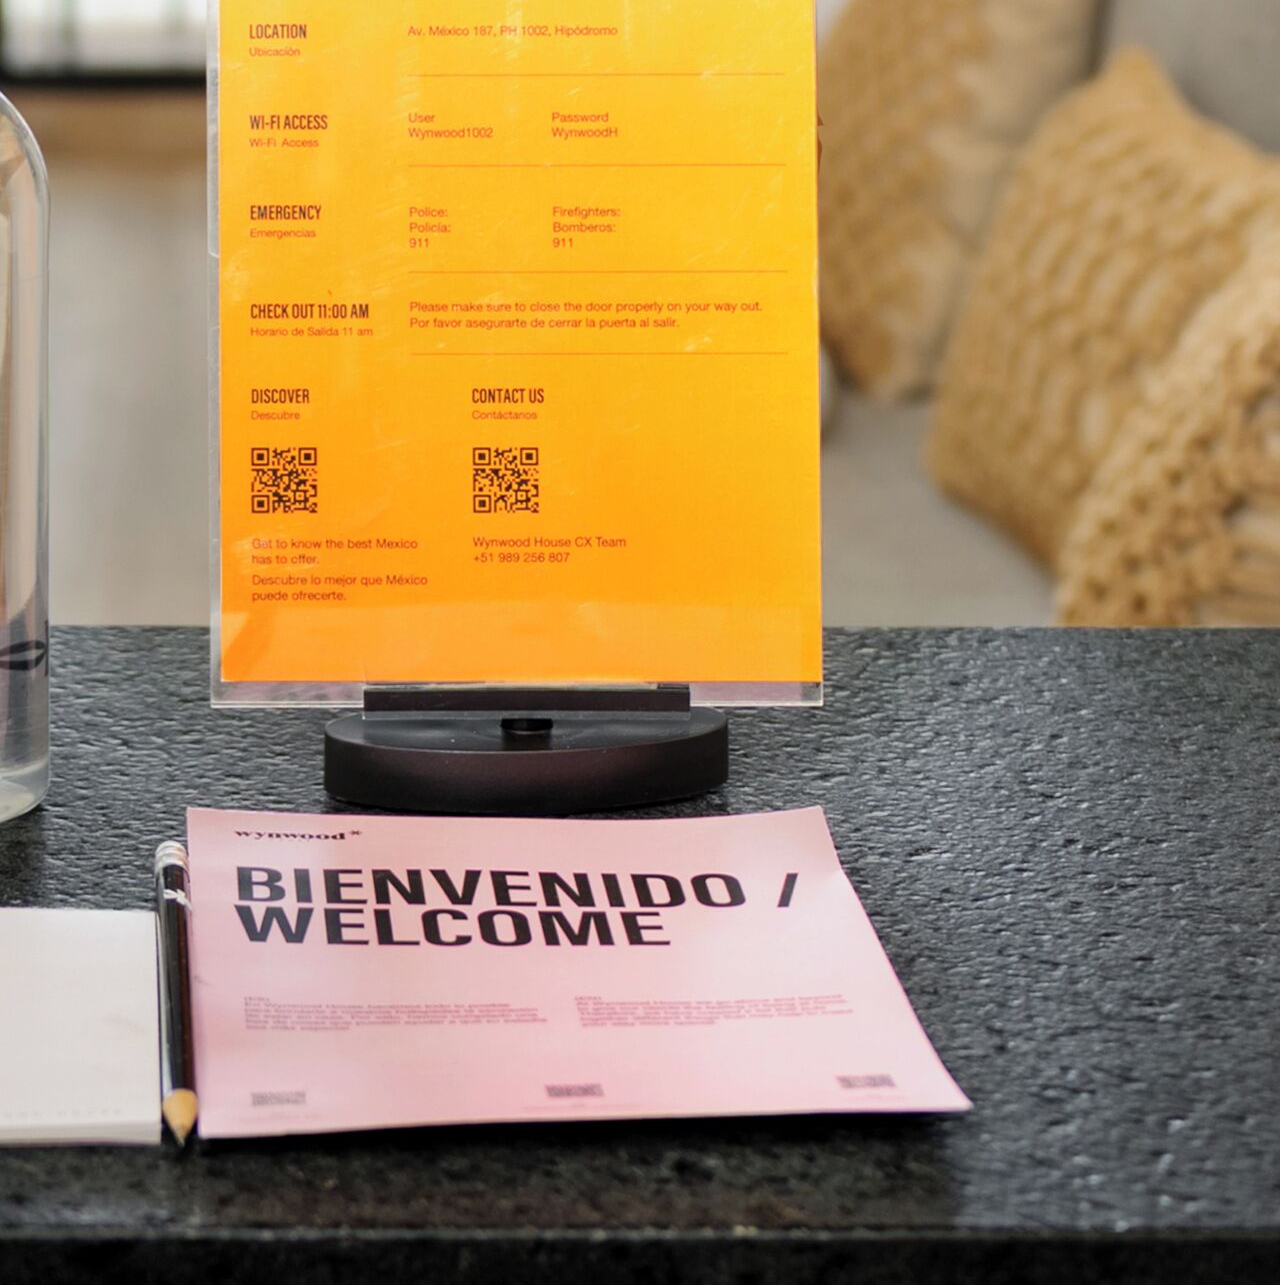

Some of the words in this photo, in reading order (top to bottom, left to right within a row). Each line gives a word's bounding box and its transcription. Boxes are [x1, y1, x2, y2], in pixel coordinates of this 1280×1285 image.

[249, 24, 307, 39] LOCATION
[408, 26, 425, 36] Av.
[429, 26, 470, 36] México
[473, 25, 496, 37] 187,
[499, 25, 517, 36] PH
[521, 25, 551, 37] 1002,
[555, 26, 618, 37] Hipódromo
[249, 47, 301, 57] Ubicación
[250, 115, 280, 130] WI-FI
[283, 114, 328, 130] ACCESS
[408, 113, 435, 123] User
[552, 112, 609, 123] Password
[408, 127, 493, 140] Wynwood1002
[551, 127, 618, 140] WynwoodH
[249, 138, 276, 147] Wi-Fi
[281, 138, 319, 148] Access
[250, 205, 321, 220] EMERGENCY
[409, 206, 448, 217] Police:
[552, 206, 620, 219] Firefighters:
[409, 222, 451, 233] Policía:
[553, 222, 615, 233] Bomberos:
[250, 228, 316, 240] Emergencias
[409, 237, 429, 248] 911
[552, 237, 573, 248] 911
[251, 304, 289, 319] CHECK
[292, 304, 315, 319] OUT
[318, 304, 347, 319] 11:00
[350, 304, 369, 318] AM
[410, 301, 448, 312] Please
[451, 302, 484, 312] make
[486, 303, 512, 312] sure
[515, 302, 526, 312] to
[530, 302, 560, 312] close
[564, 302, 582, 312] the
[585, 302, 612, 312] door
[616, 301, 664, 314] properly
[667, 303, 682, 311] on
[685, 303, 710, 314] your
[714, 303, 737, 313] way
[740, 302, 762, 311] out.
[410, 318, 430, 328] Por
[433, 318, 462, 328] favor
[465, 319, 527, 330] asegurarte
[530, 318, 545, 328] de
[548, 319, 582, 328] cerrar
[586, 318, 596, 328] la
[599, 318, 636, 330] puerta
[639, 318, 650, 328] al
[653, 317, 679, 328] salir.
[250, 327, 288, 336] Horario
[291, 327, 304, 336] de
[307, 326, 339, 336] Salida
[357, 328, 373, 336] am
[252, 389, 309, 404] DISCOVER
[472, 388, 525, 403] CONTACT
[529, 388, 544, 403] US
[251, 410, 301, 420] Descubre
[472, 410, 538, 420] Contáctanos
[275, 539, 288, 549] to
[290, 538, 322, 549] know
[325, 539, 344, 549] the
[347, 539, 372, 549] best
[376, 538, 418, 549] Mexico
[473, 537, 530, 549] Wynwood
[534, 537, 571, 547] House
[575, 536, 592, 547] CX
[595, 536, 626, 547] Team
[252, 555, 272, 565] has
[275, 555, 288, 564] to
[474, 552, 493, 563] +51
[498, 552, 520, 563] 989
[524, 552, 545, 562] 256
[548, 552, 570, 563] 807
[252, 574, 308, 585] Descubre
[311, 575, 321, 585] lo
[324, 575, 357, 587] mejor
[360, 576, 383, 587] que
[386, 575, 428, 585] México
[252, 591, 288, 602] puede
[292, 590, 346, 601] ofrecerte.
[236, 865, 746, 908] BIENVENIDO
[234, 904, 671, 947] WELCOME
